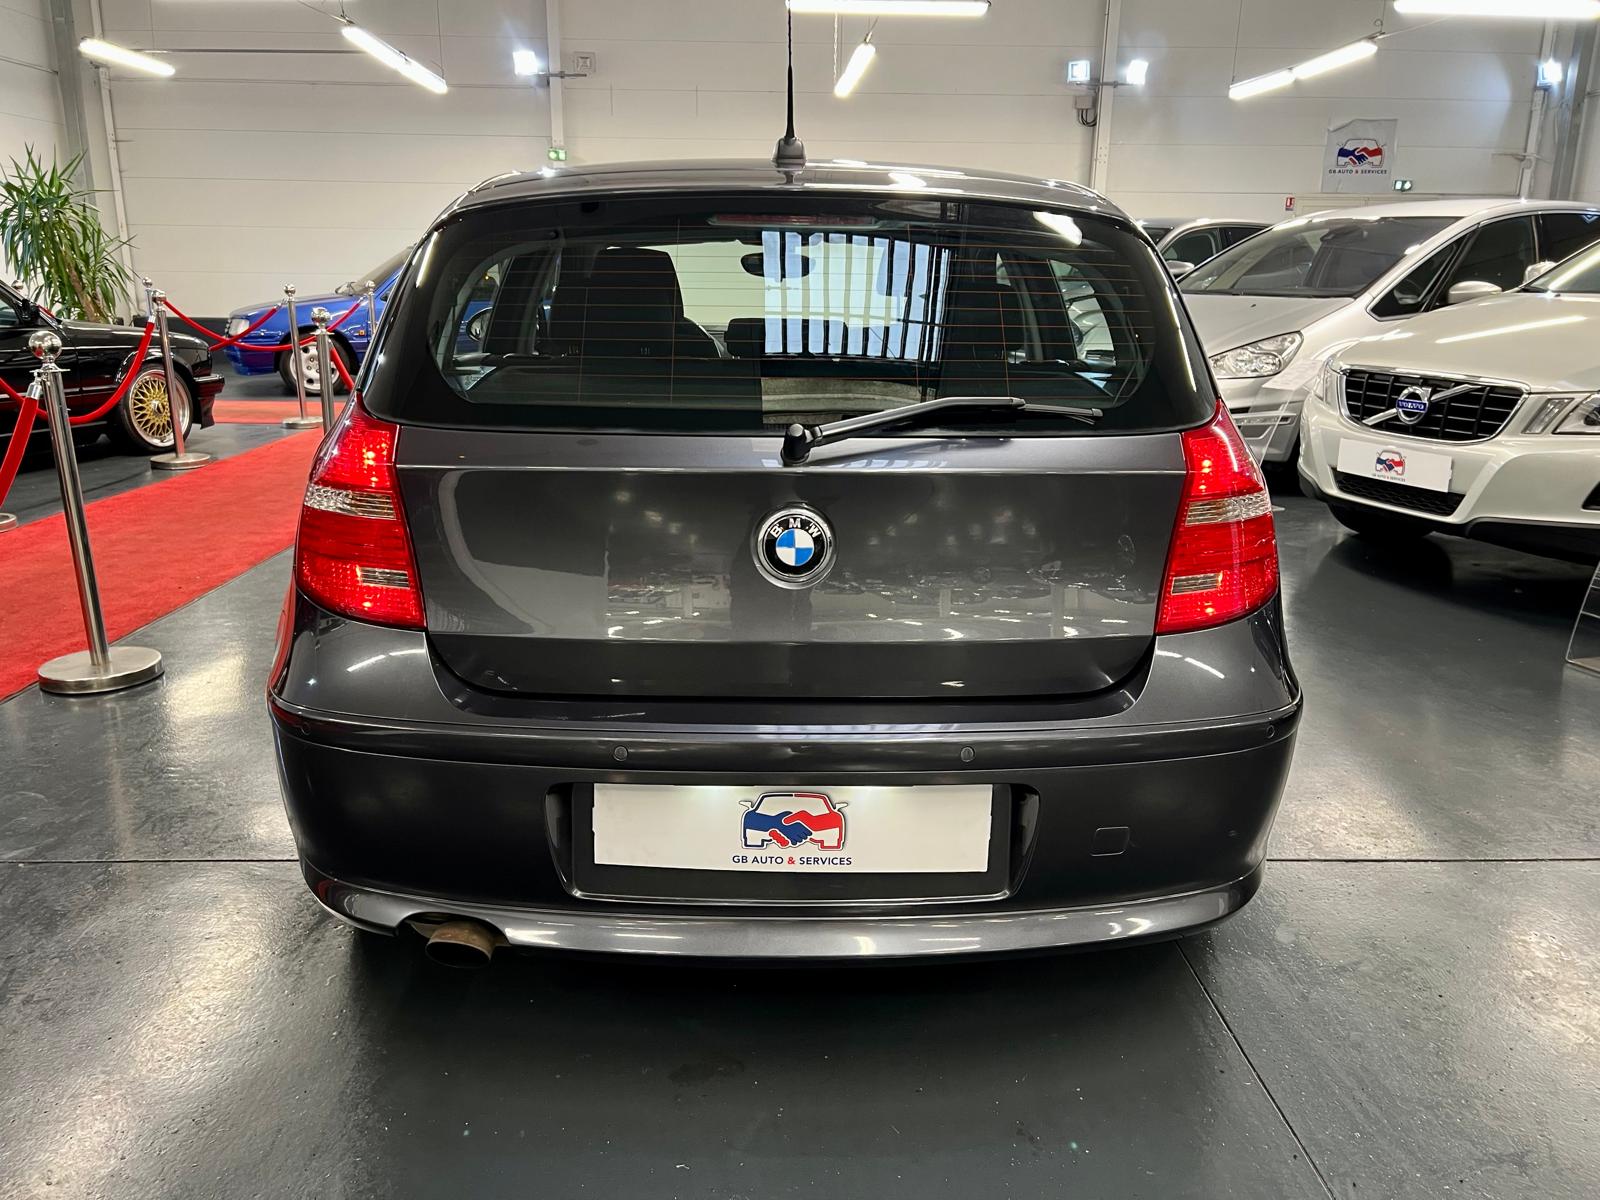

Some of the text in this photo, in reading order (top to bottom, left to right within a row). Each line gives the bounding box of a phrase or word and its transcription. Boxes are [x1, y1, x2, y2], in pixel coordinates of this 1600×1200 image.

[1398, 400, 1425, 410] VOLVO
[769, 517, 821, 539] BMW
[732, 855, 852, 865] GB AUTO & SERVICES
